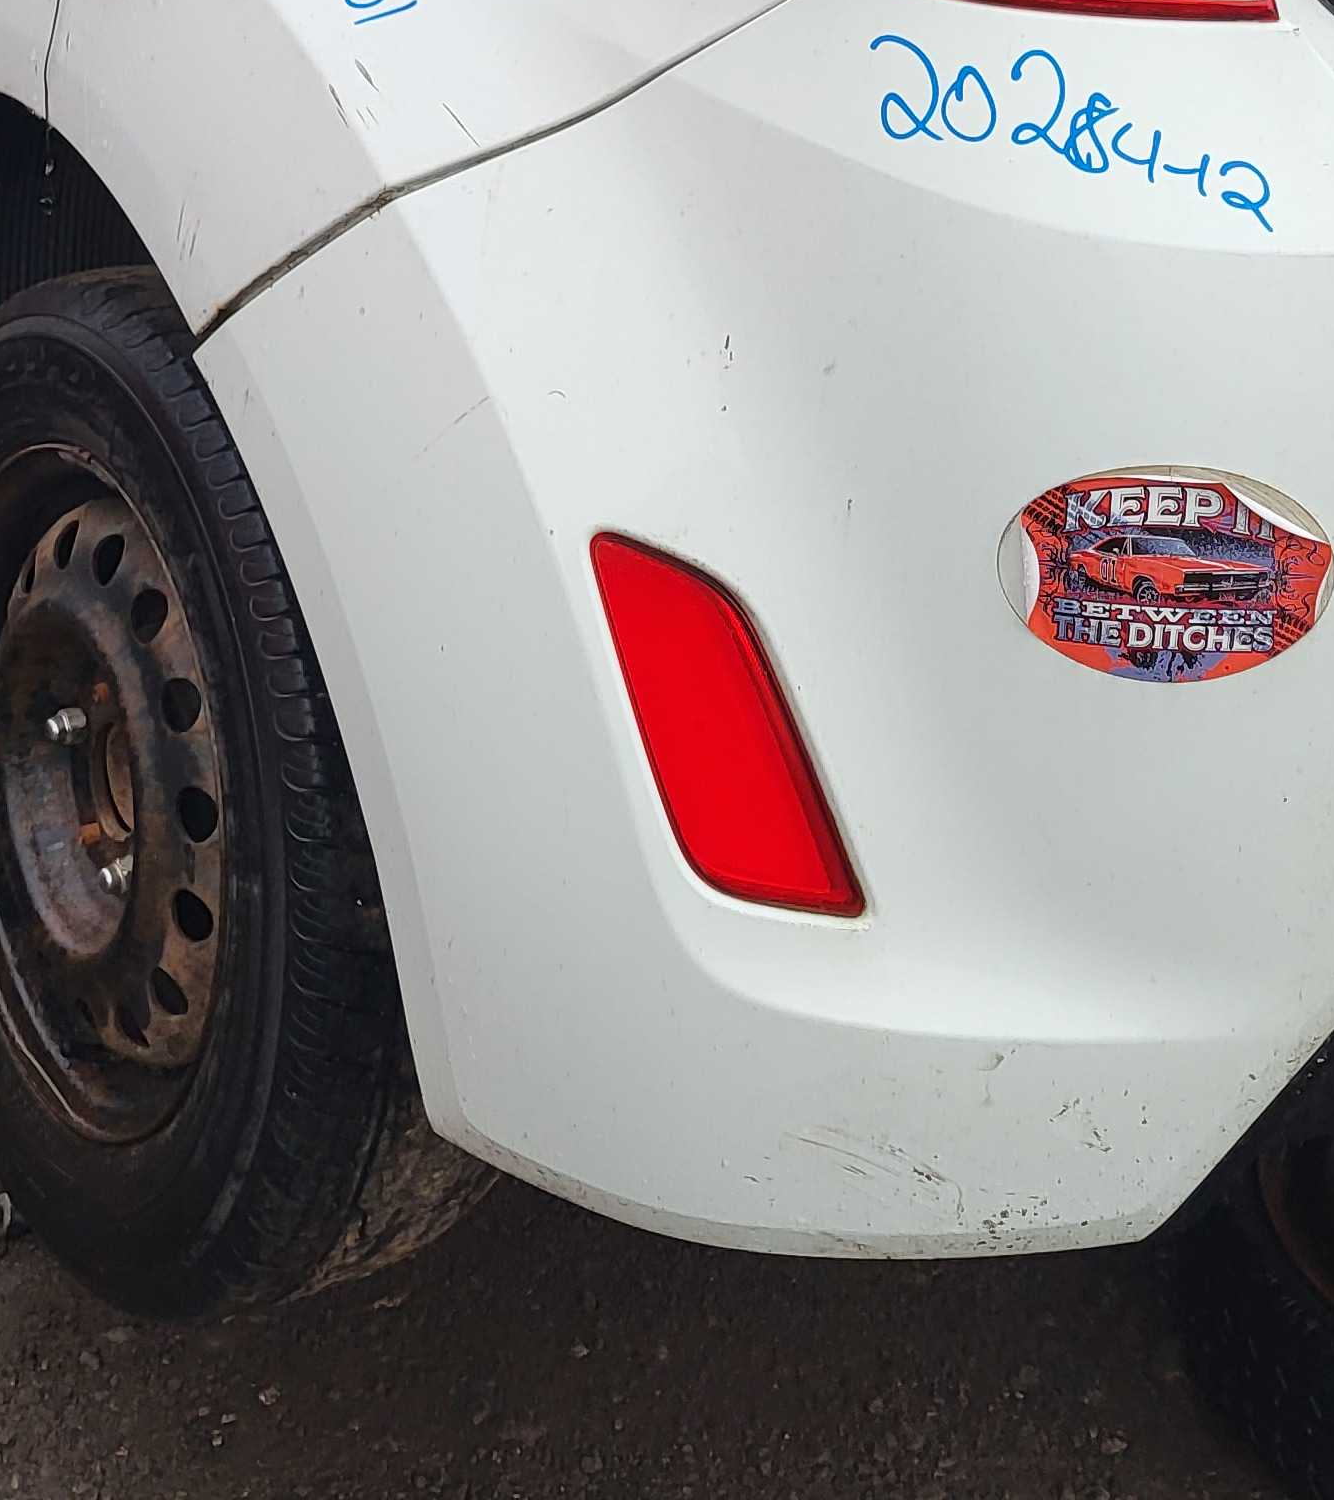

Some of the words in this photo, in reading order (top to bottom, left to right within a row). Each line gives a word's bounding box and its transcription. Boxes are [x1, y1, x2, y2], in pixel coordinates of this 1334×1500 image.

[869, 32, 1274, 234] 20284-12
[1063, 485, 1224, 530] KEEP
[1054, 598, 1277, 626] BETWEEN
[1054, 614, 1122, 648] THE
[1127, 622, 1274, 652] DITCHES
